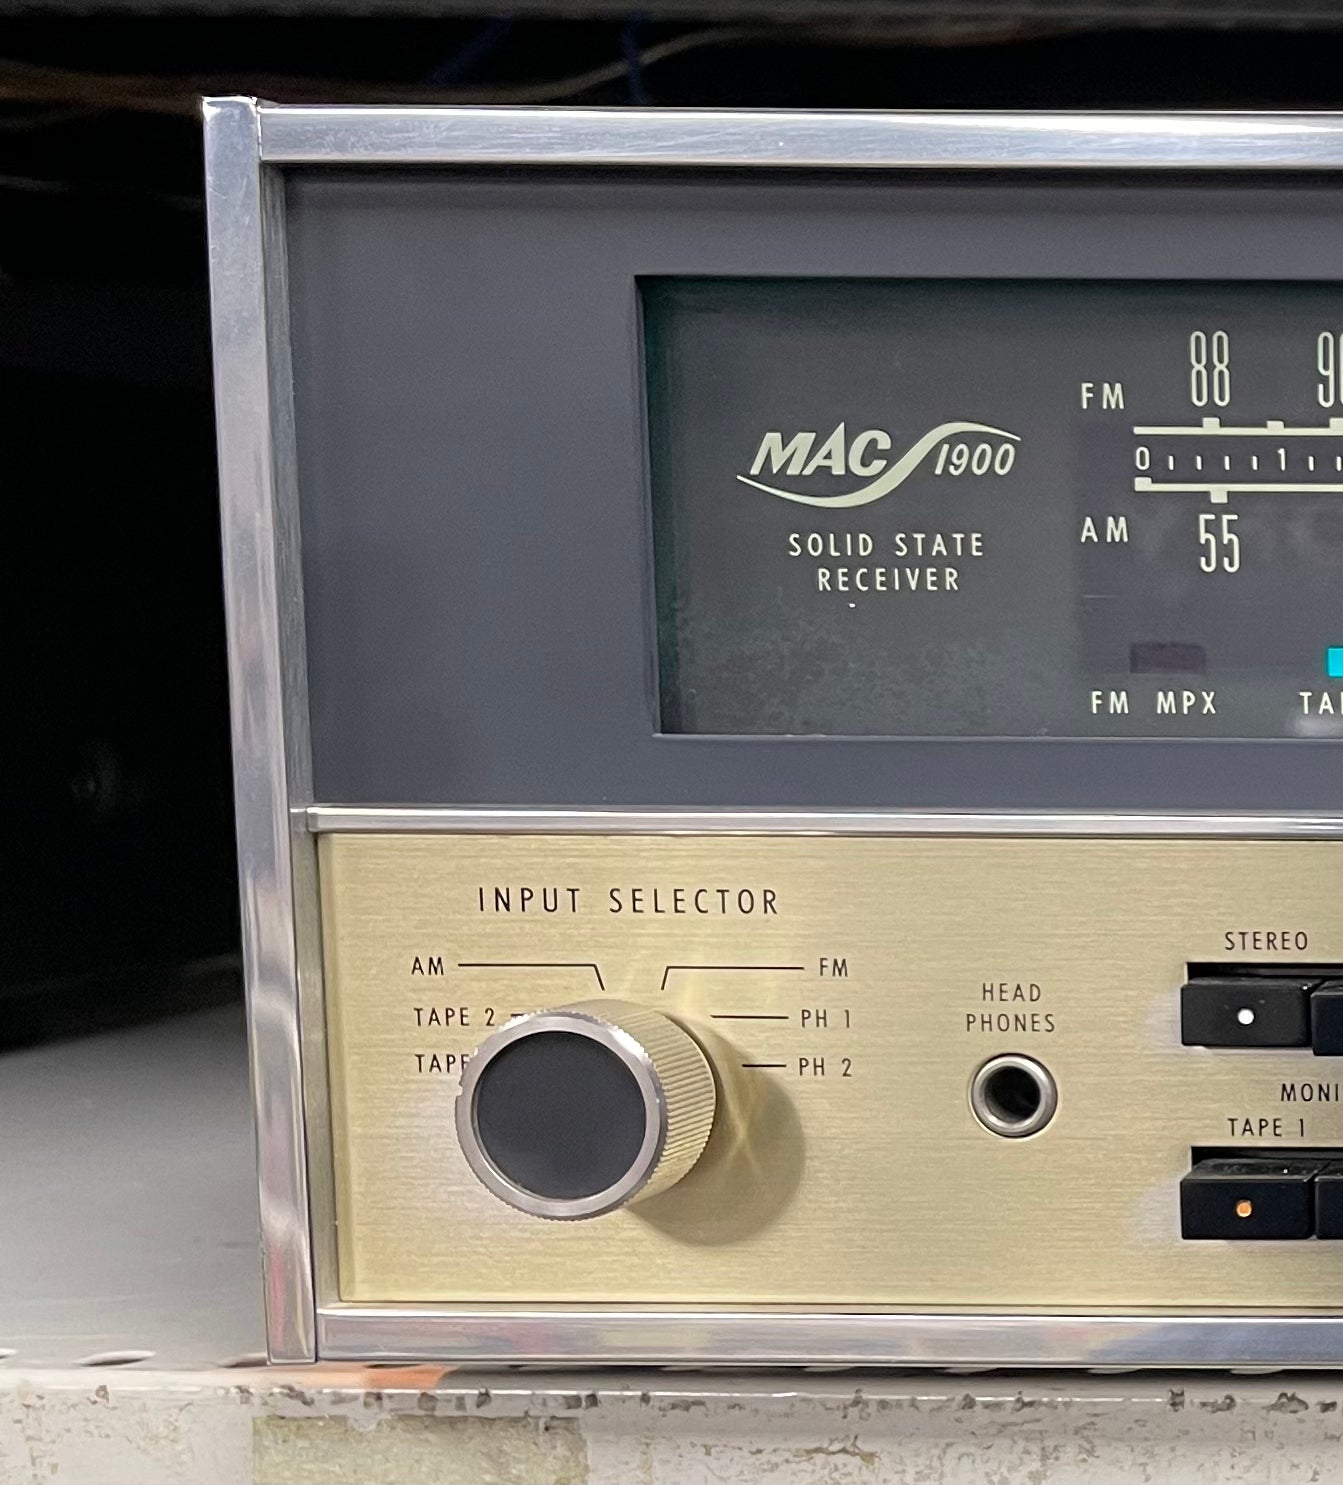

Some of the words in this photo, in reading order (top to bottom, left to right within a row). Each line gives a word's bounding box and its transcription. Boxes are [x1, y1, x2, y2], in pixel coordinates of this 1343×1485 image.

[1081, 382, 1125, 410] FM
[1190, 330, 1231, 407] 88
[750, 421, 892, 476] MAC
[934, 443, 1015, 475] 1900
[1135, 446, 1150, 471] 0
[1277, 447, 1286, 471] 1
[788, 532, 873, 557] SOLID
[895, 532, 983, 557] STATE
[1080, 516, 1129, 543] AM
[1198, 513, 1240, 573] 55
[818, 567, 959, 592] RECEIVER
[1091, 690, 1129, 714] FM
[1156, 690, 1216, 715] MPX
[479, 886, 580, 913] INPUT
[609, 887, 778, 915] SELECTOR
[1224, 931, 1308, 951] STEREO
[411, 956, 444, 976] AM
[819, 957, 848, 978] FM
[982, 982, 1041, 1003] HEAD
[413, 1007, 469, 1027] TAPE
[484, 1007, 495, 1027] 2
[801, 1008, 828, 1028] PH
[844, 1009, 850, 1029] 1
[966, 1013, 1055, 1033] PHONES
[799, 1057, 825, 1077] PH
[841, 1057, 852, 1078] 2
[1227, 1117, 1282, 1138] TAPE
[1299, 1118, 1304, 1138] 1
